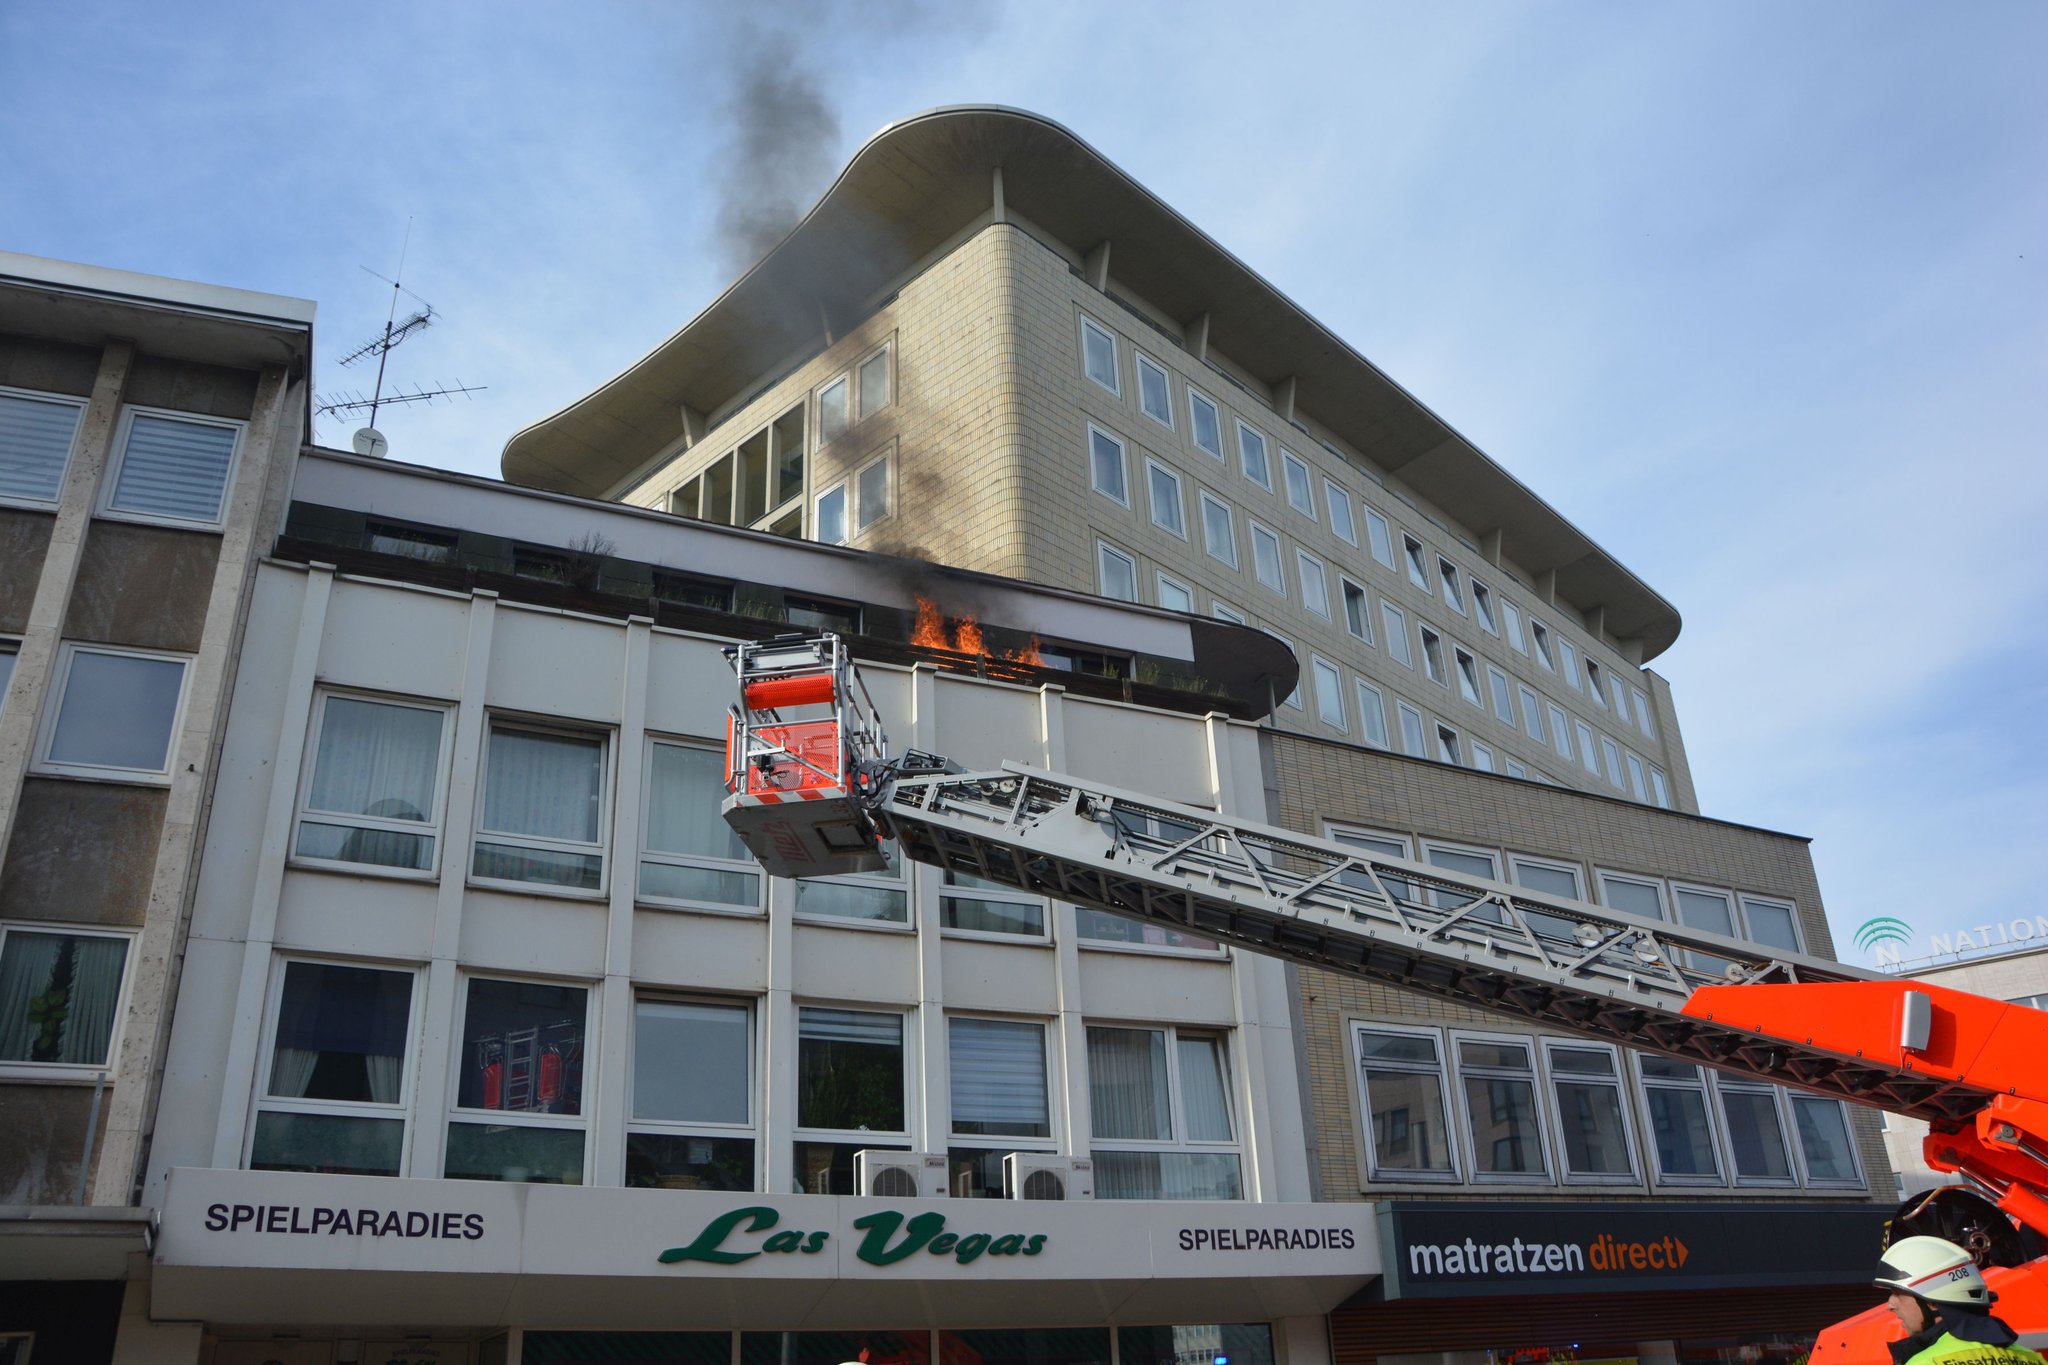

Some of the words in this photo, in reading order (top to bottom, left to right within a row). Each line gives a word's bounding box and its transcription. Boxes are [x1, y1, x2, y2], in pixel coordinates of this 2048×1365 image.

[1875, 942, 1900, 967] N
[204, 1203, 485, 1240] SPIELPARADIES
[657, 1206, 830, 1264] Las
[853, 1210, 1048, 1266] Vegas
[1178, 1228, 1356, 1251] SPIELPARADIES
[1409, 1237, 1585, 1274] matratzen
[1589, 1233, 1679, 1271] direct
[1949, 1267, 1970, 1282] 208
